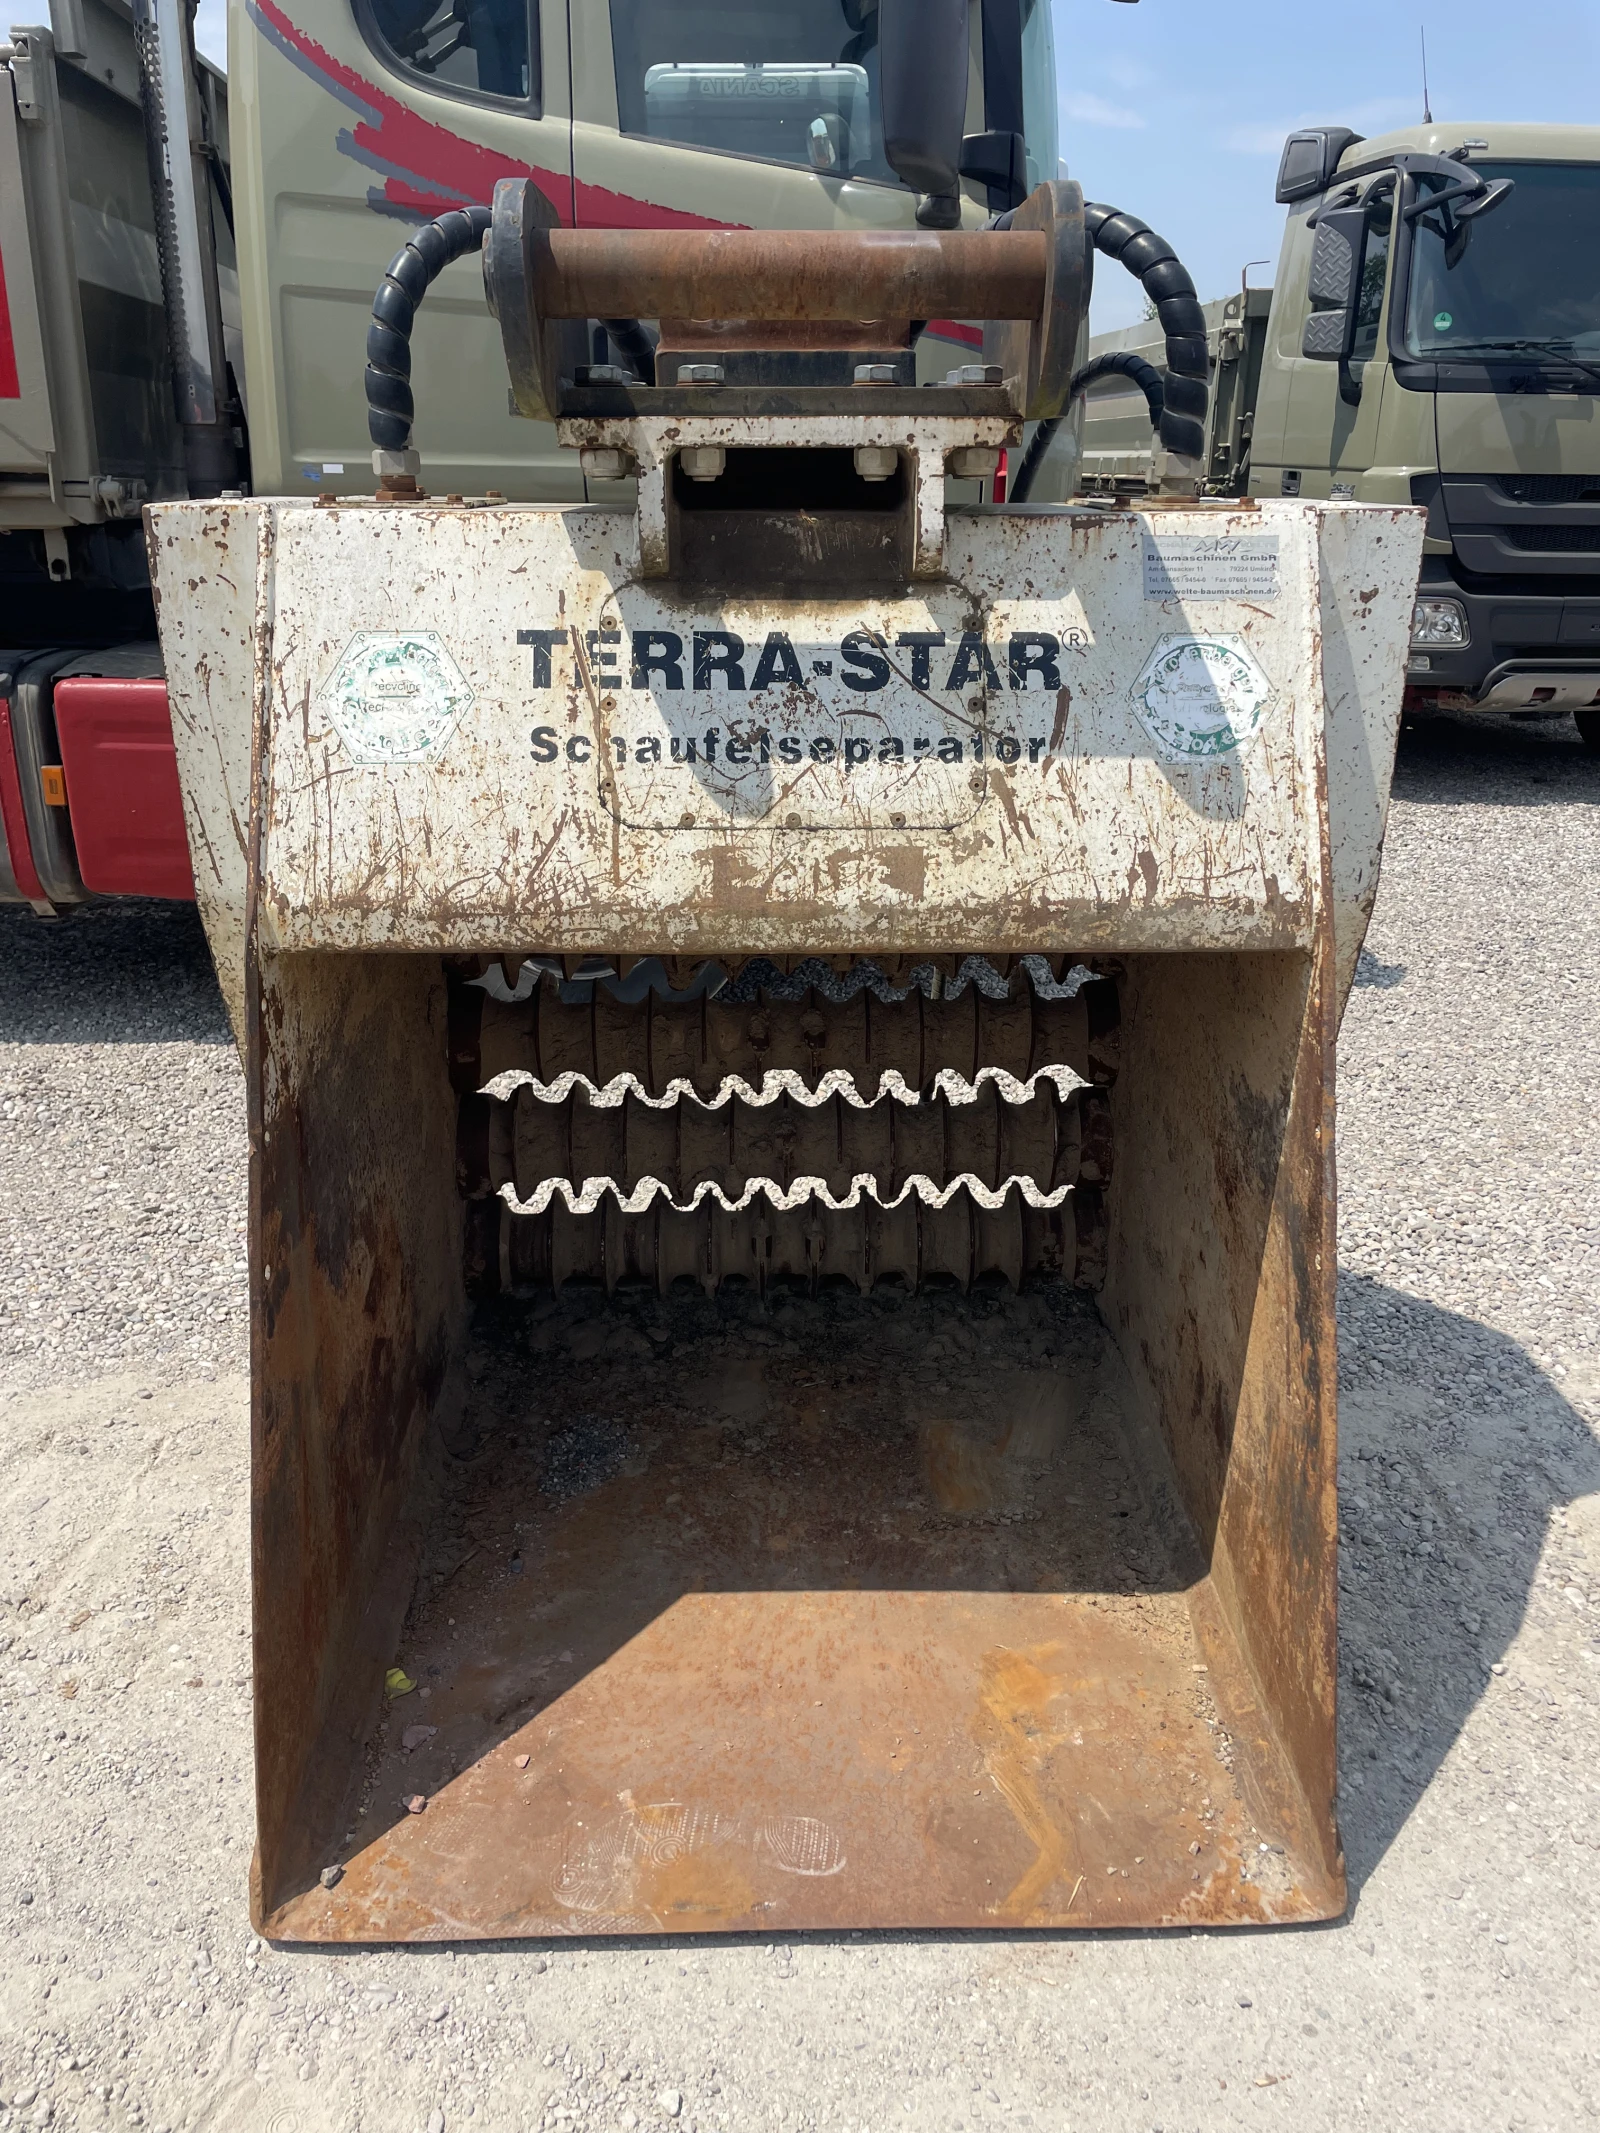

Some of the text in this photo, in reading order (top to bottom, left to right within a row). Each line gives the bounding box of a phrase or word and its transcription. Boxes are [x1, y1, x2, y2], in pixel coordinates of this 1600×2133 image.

[1440, 312, 1446, 321] 4
[1147, 554, 1277, 562] Baumaschinen GmbH
[530, 725, 1046, 773] Schaufelseparator
